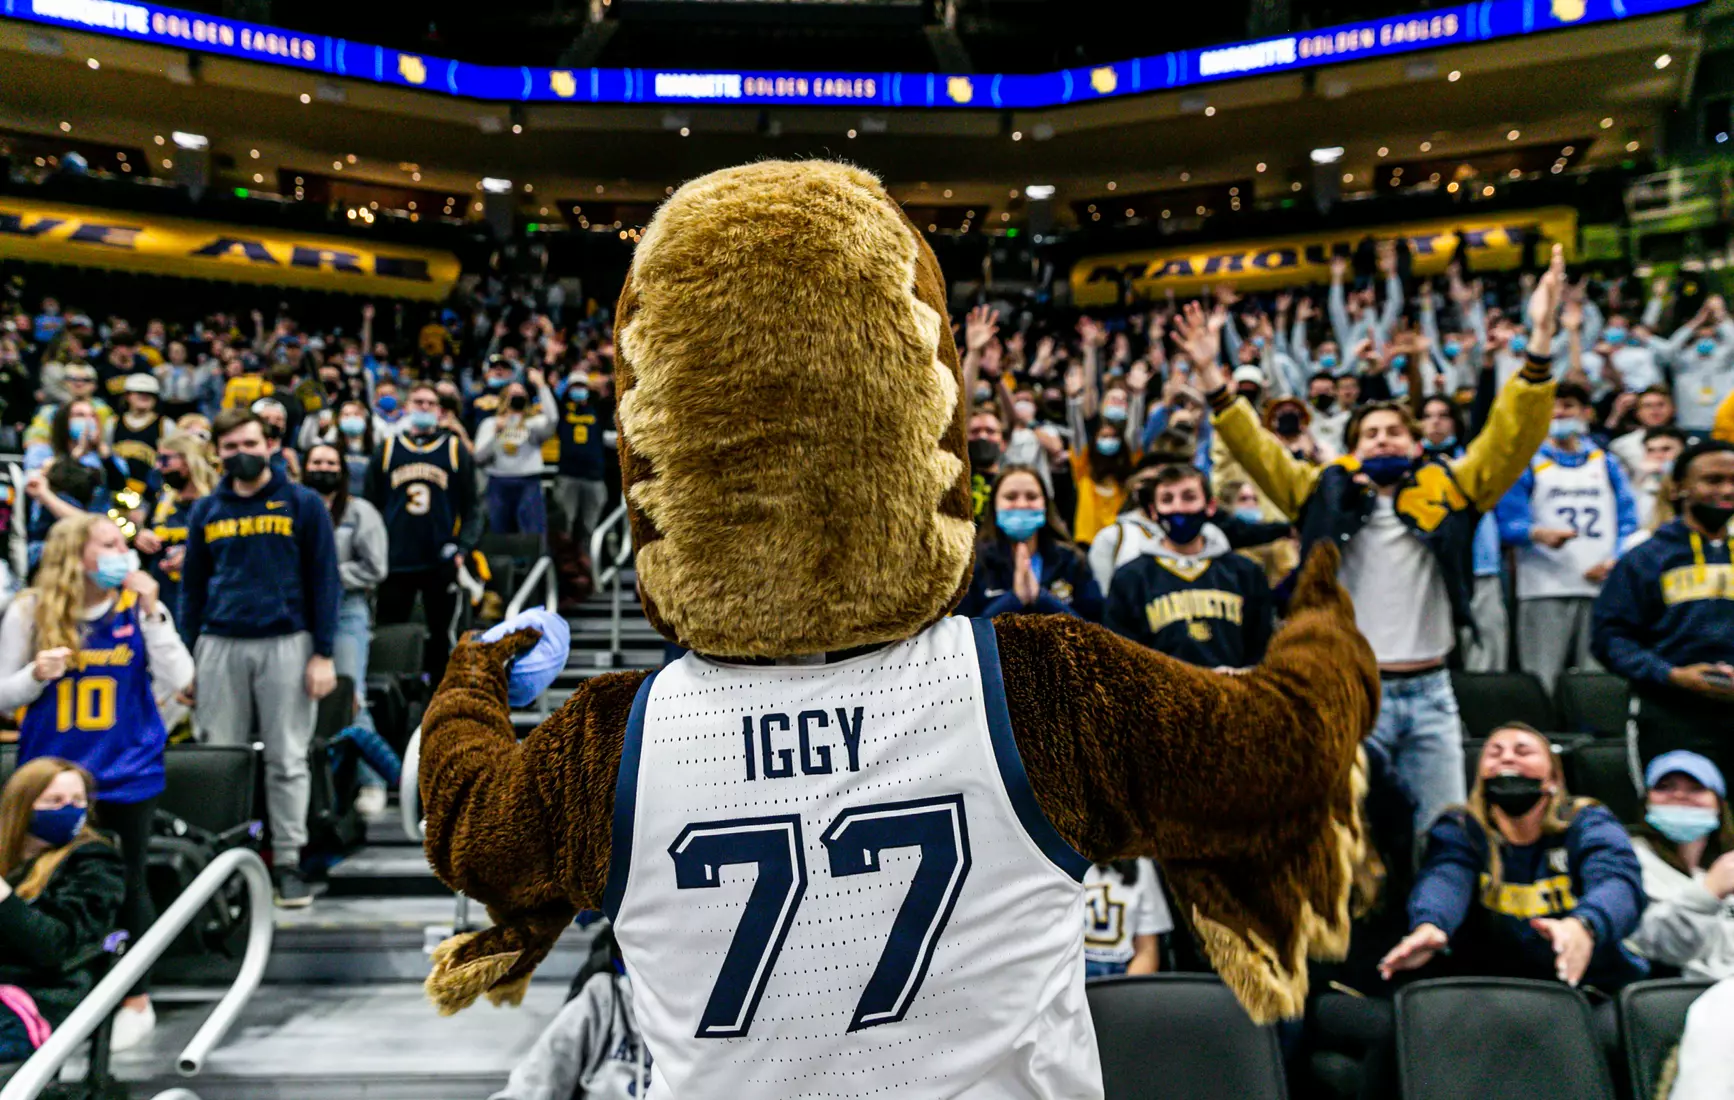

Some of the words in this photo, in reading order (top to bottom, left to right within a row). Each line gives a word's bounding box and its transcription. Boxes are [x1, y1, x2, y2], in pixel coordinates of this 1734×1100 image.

[152, 12, 234, 47] GOLDEN
[240, 28, 316, 62] EAGLES
[1299, 27, 1375, 59] GOLDEN
[1380, 13, 1459, 47] EAGLES
[744, 77, 808, 97] GOLDEN
[813, 77, 876, 98] EAGLES
[406, 482, 431, 515] 3
[1555, 506, 1602, 538] 32
[1145, 588, 1244, 633] MARQUETTE
[56, 675, 118, 732] 10
[742, 706, 864, 782] IGGY
[667, 793, 973, 1038] 77
